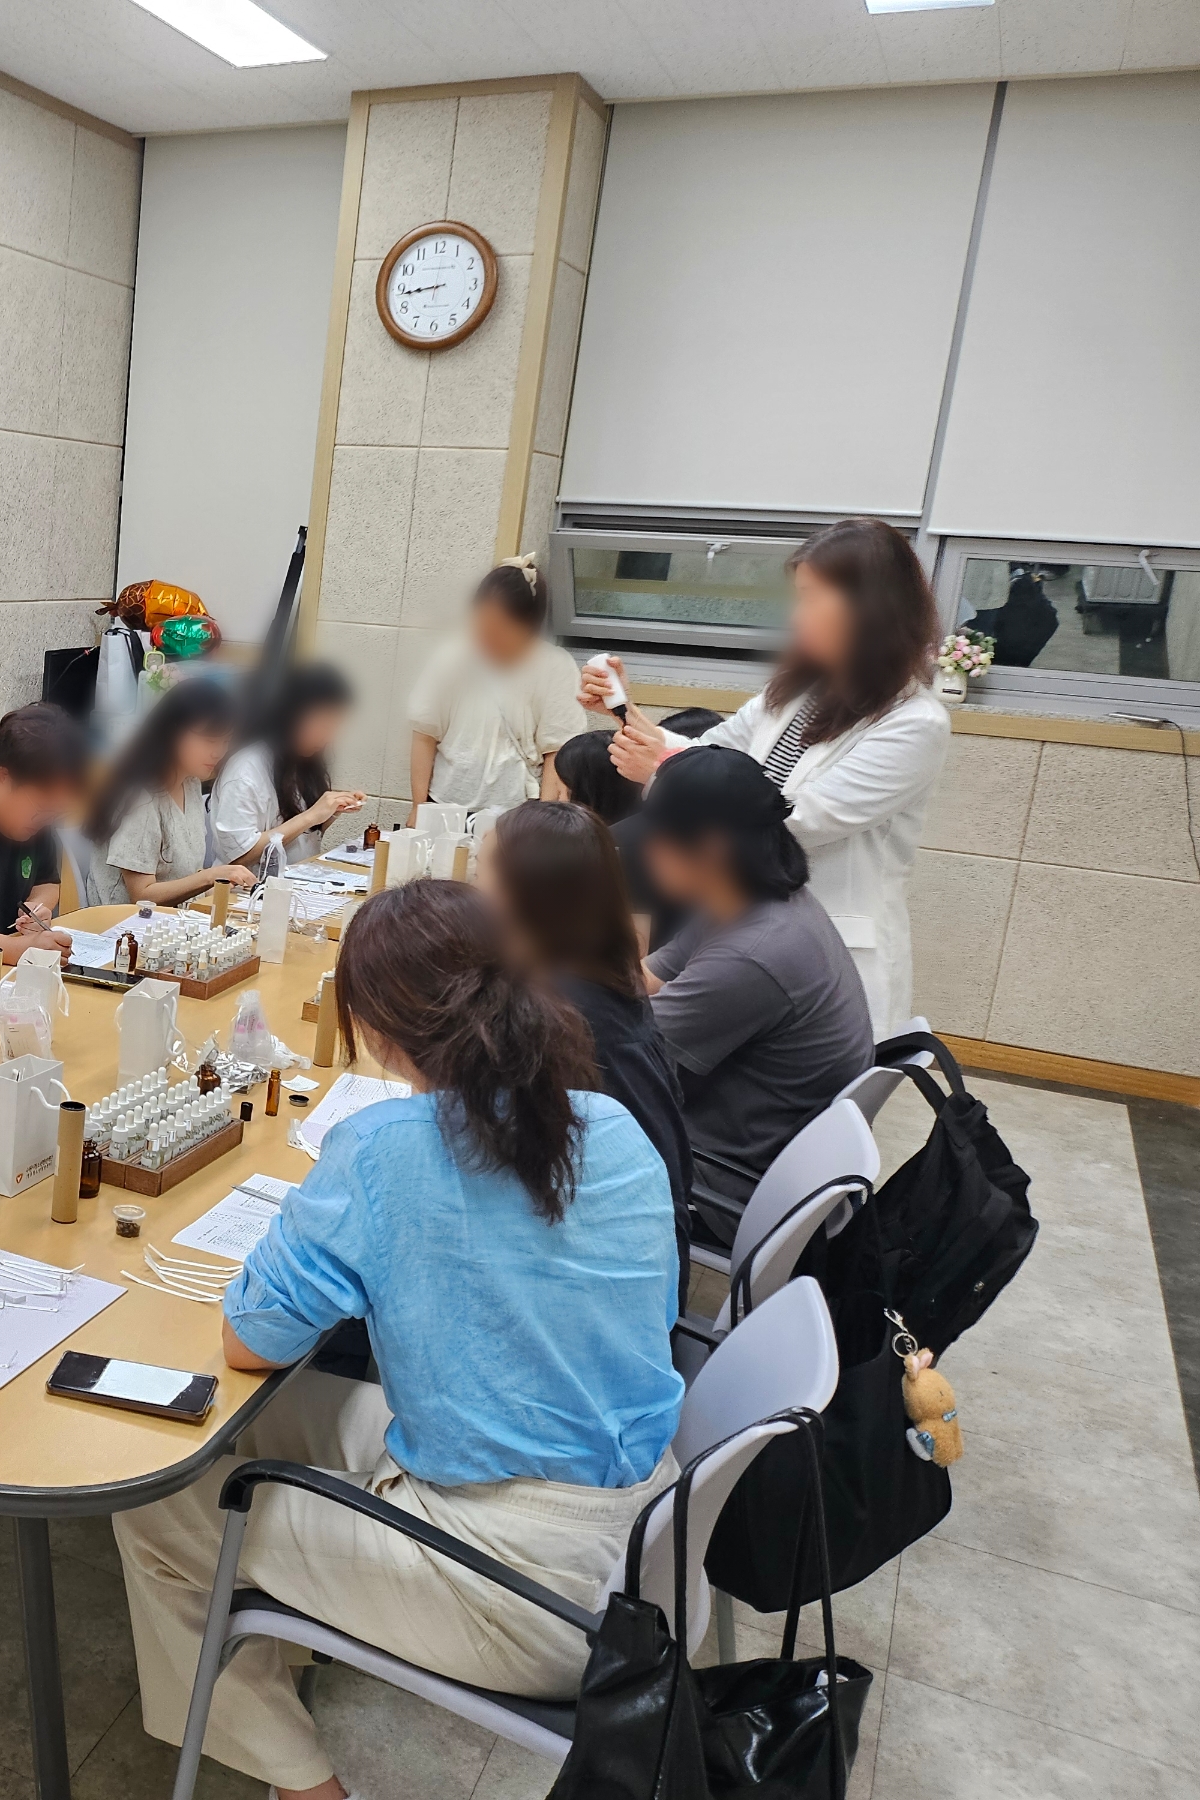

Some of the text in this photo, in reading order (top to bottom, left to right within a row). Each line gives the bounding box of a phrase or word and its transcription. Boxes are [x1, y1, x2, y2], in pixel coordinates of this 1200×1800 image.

[416, 247, 426, 260] 11
[434, 241, 446, 254] 12
[455, 245, 460, 257] 1
[402, 263, 414, 276] 10
[466, 257, 475, 270] 2
[397, 283, 406, 295] 9
[469, 278, 478, 291] 3
[399, 301, 409, 314] 8
[461, 297, 470, 309] 4
[412, 315, 420, 328] 7
[429, 320, 438, 332] 6
[448, 313, 457, 326] 5
